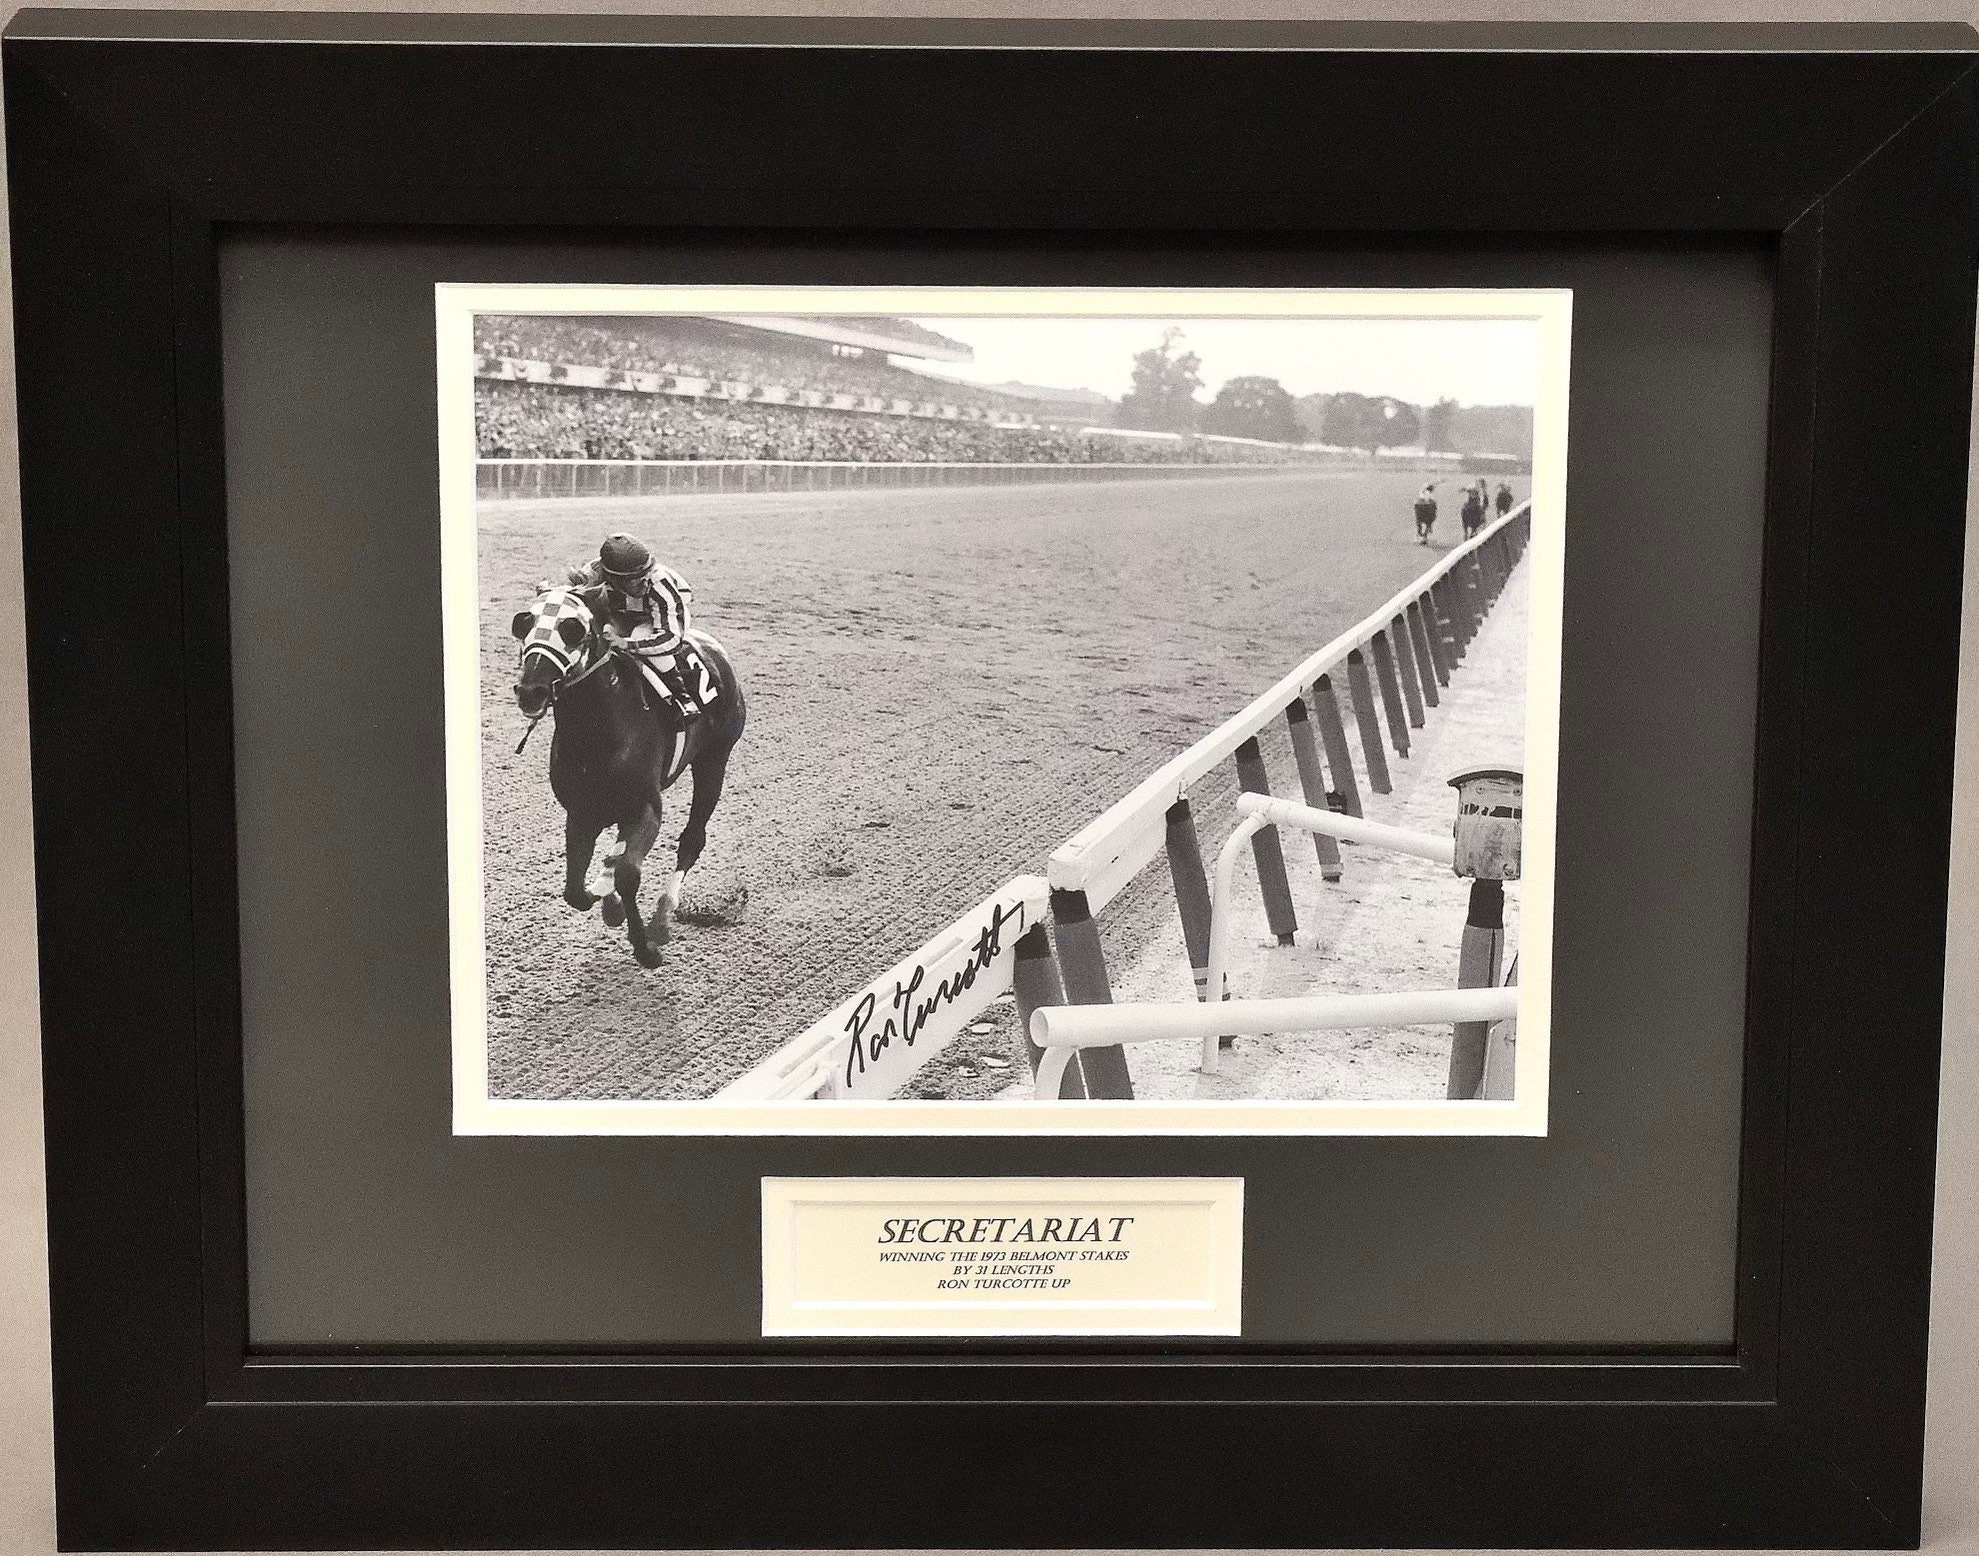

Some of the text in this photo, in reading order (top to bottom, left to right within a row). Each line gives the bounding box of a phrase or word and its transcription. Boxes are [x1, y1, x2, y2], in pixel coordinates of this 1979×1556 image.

[686, 652, 719, 705] 2
[844, 992, 898, 1088] Ron
[878, 1217, 1134, 1243] SECRETARIAT
[879, 1250, 1130, 1262] WINNING THE 1973 BELMONT STAKES
[953, 1264, 1055, 1275] BY 31 LENGTHS
[937, 1278, 1071, 1289] RON TURCOTTE UP
